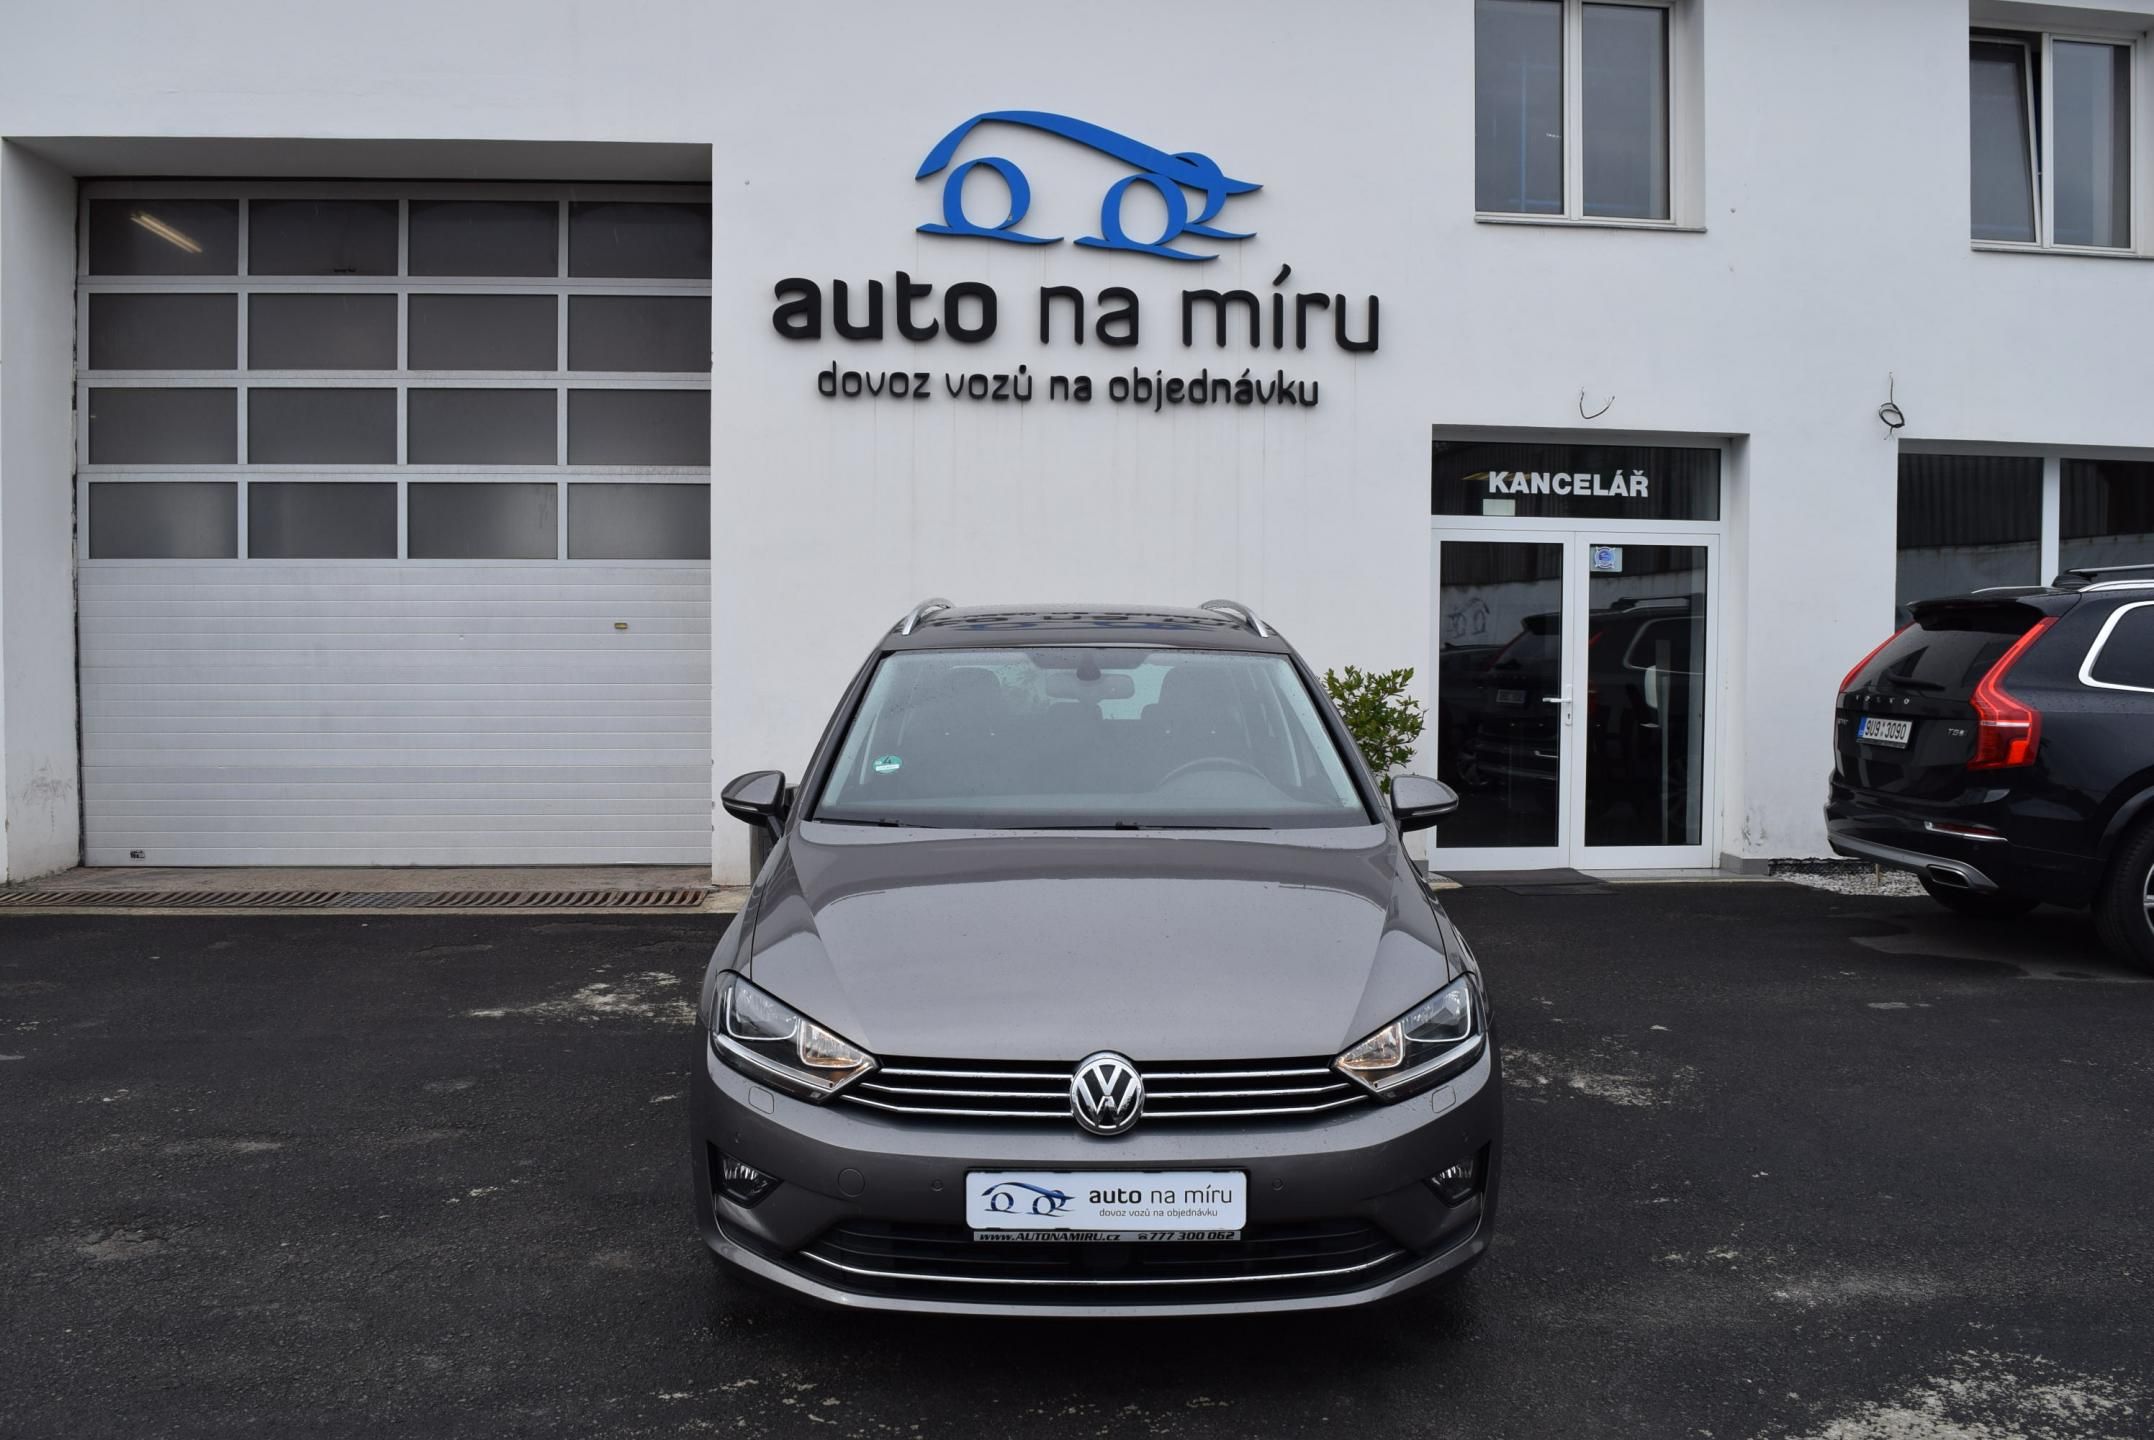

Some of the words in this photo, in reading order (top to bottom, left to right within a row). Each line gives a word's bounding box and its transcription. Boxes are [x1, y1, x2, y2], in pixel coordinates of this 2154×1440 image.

[772, 270, 998, 344] auto
[1039, 285, 1140, 347] na
[1181, 263, 1380, 353] míru
[817, 359, 932, 399] dovoz
[944, 363, 1033, 402] vozů
[1049, 374, 1093, 403] na
[1108, 366, 1319, 413] objednávku
[1488, 469, 1649, 498] KANCELÁŘ
[1089, 1188, 1142, 1204] auto
[1151, 1189, 1175, 1204] na
[1184, 1184, 1232, 1204] míru
[1099, 1208, 1126, 1217] dovoz
[1153, 1209, 1164, 1217] na
[1166, 1208, 1218, 1219] objednávku
[980, 1232, 1121, 1241] www.AUTONAMIRU.cz
[1150, 1232, 1175, 1241] 777
[1176, 1232, 1205, 1241] 300
[1207, 1231, 1235, 1240] 062
